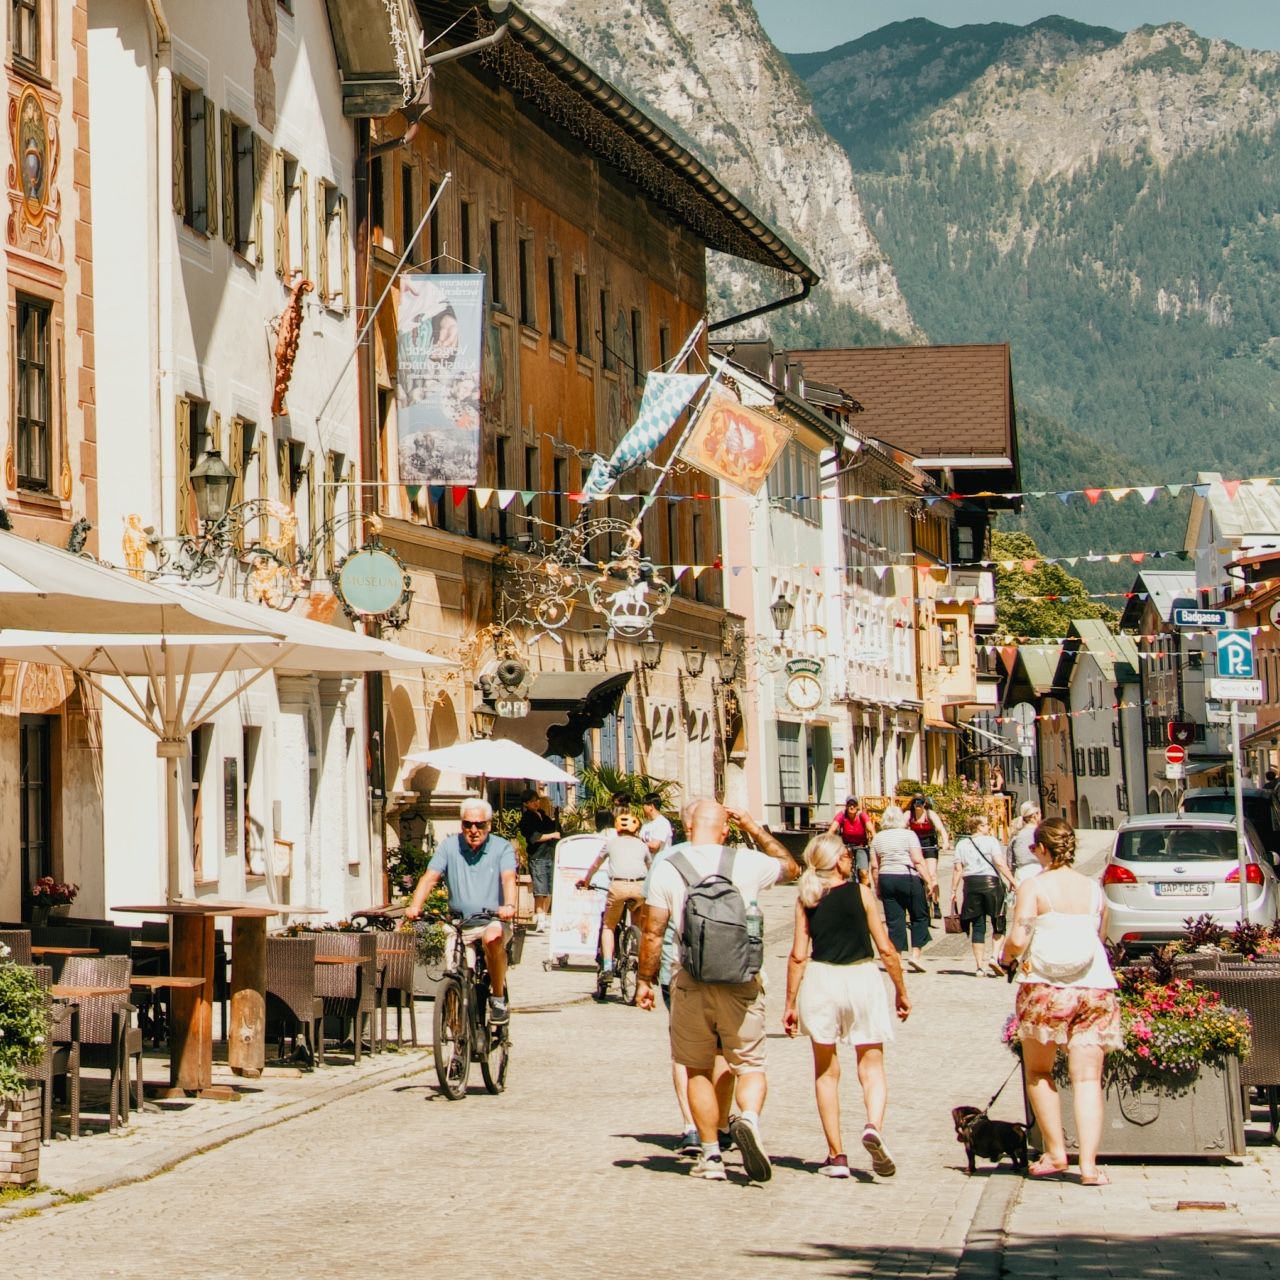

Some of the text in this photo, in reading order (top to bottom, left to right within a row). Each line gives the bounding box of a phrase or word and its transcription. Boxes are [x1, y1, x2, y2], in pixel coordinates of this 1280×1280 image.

[347, 575, 398, 588] MUSEUM
[1181, 610, 1222, 625] Badgasse
[1228, 644, 1245, 674] P
[788, 660, 819, 673] Juwelier
[1161, 884, 1208, 893] GAP CF 65
